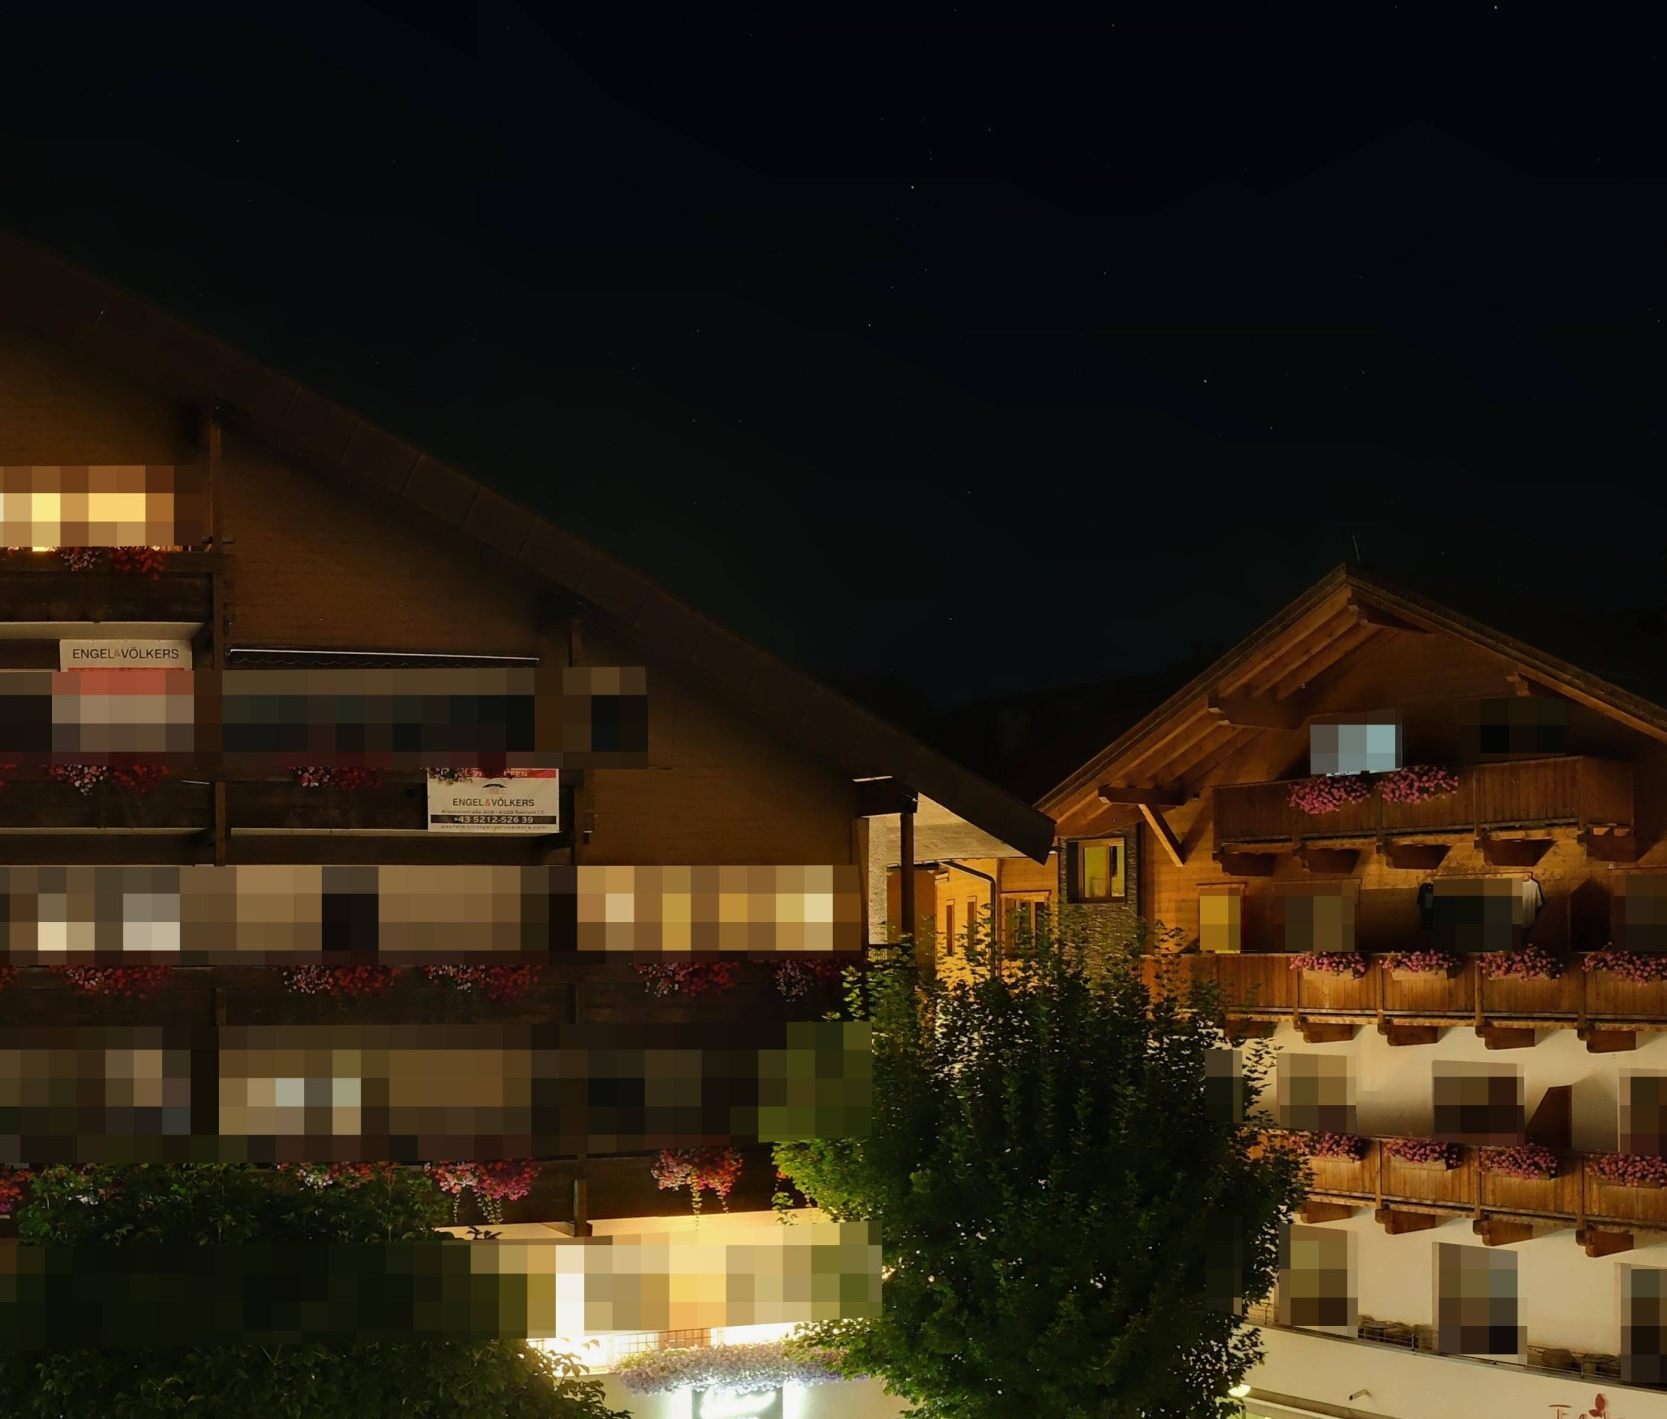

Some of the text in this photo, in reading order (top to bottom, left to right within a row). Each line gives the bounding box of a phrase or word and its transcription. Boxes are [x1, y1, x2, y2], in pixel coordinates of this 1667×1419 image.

[454, 815, 534, 823] +43 5212-526 39
